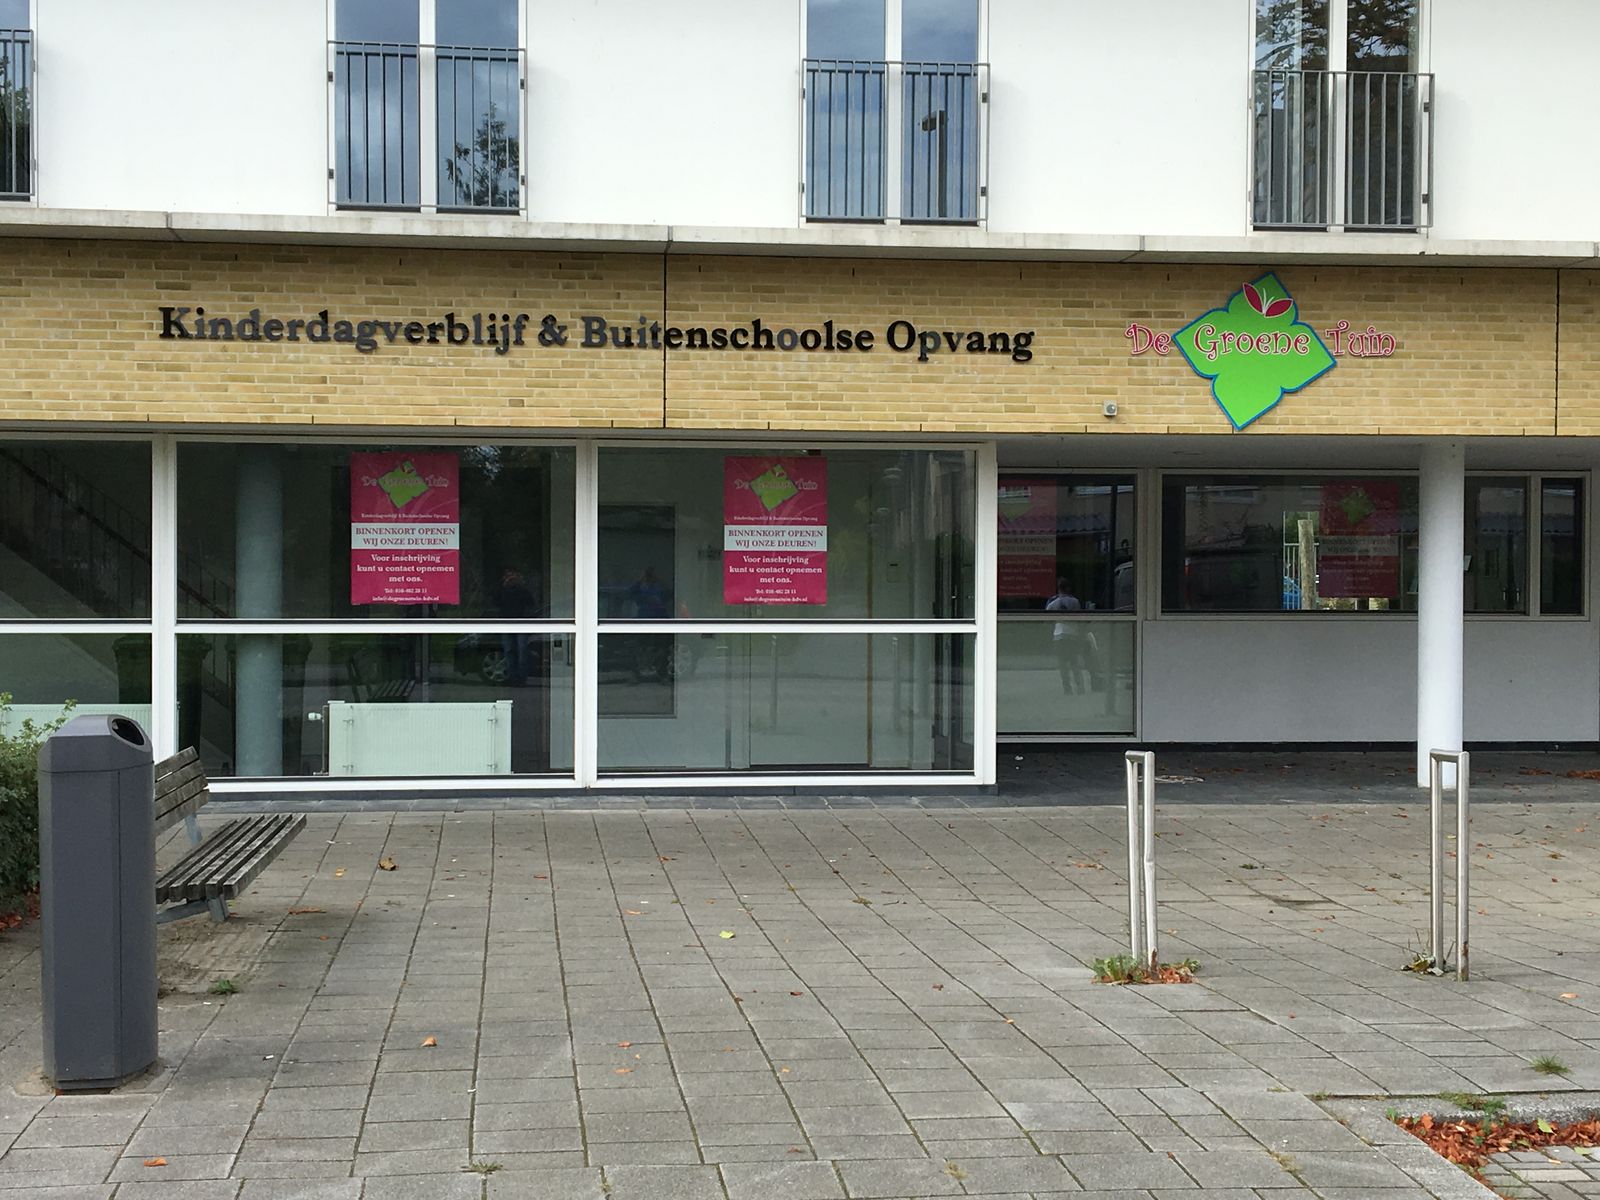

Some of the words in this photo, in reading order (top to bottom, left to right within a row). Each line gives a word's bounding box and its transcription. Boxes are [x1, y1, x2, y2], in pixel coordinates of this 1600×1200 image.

[158, 306, 530, 355] Kinderdagverblijf
[537, 314, 569, 347] &
[580, 315, 875, 353] Buitenschoolse
[886, 320, 1035, 362] Opvang
[1125, 322, 1172, 356] De
[1194, 323, 1310, 361] Groene
[1325, 319, 1397, 358] Tuin
[355, 527, 416, 535] BINNENKORT
[418, 527, 456, 535] OPENEN
[728, 529, 786, 537] BINNENKORT
[787, 529, 824, 537] OPENEN
[362, 537, 379, 547] WIJ
[380, 537, 406, 546] ONZE
[407, 537, 449, 546] DEUREN!
[735, 539, 750, 549] WIJ
[751, 539, 776, 547] ONZE
[776, 539, 817, 547] DEUREN!
[371, 554, 390, 562] Voor
[391, 554, 441, 564] inschrijving
[742, 555, 761, 563] Voor
[762, 555, 809, 565] inschrijving
[356, 564, 376, 572] kunt
[416, 566, 455, 574] opnemen
[729, 565, 748, 573] kunt
[785, 567, 823, 575] opnemen
